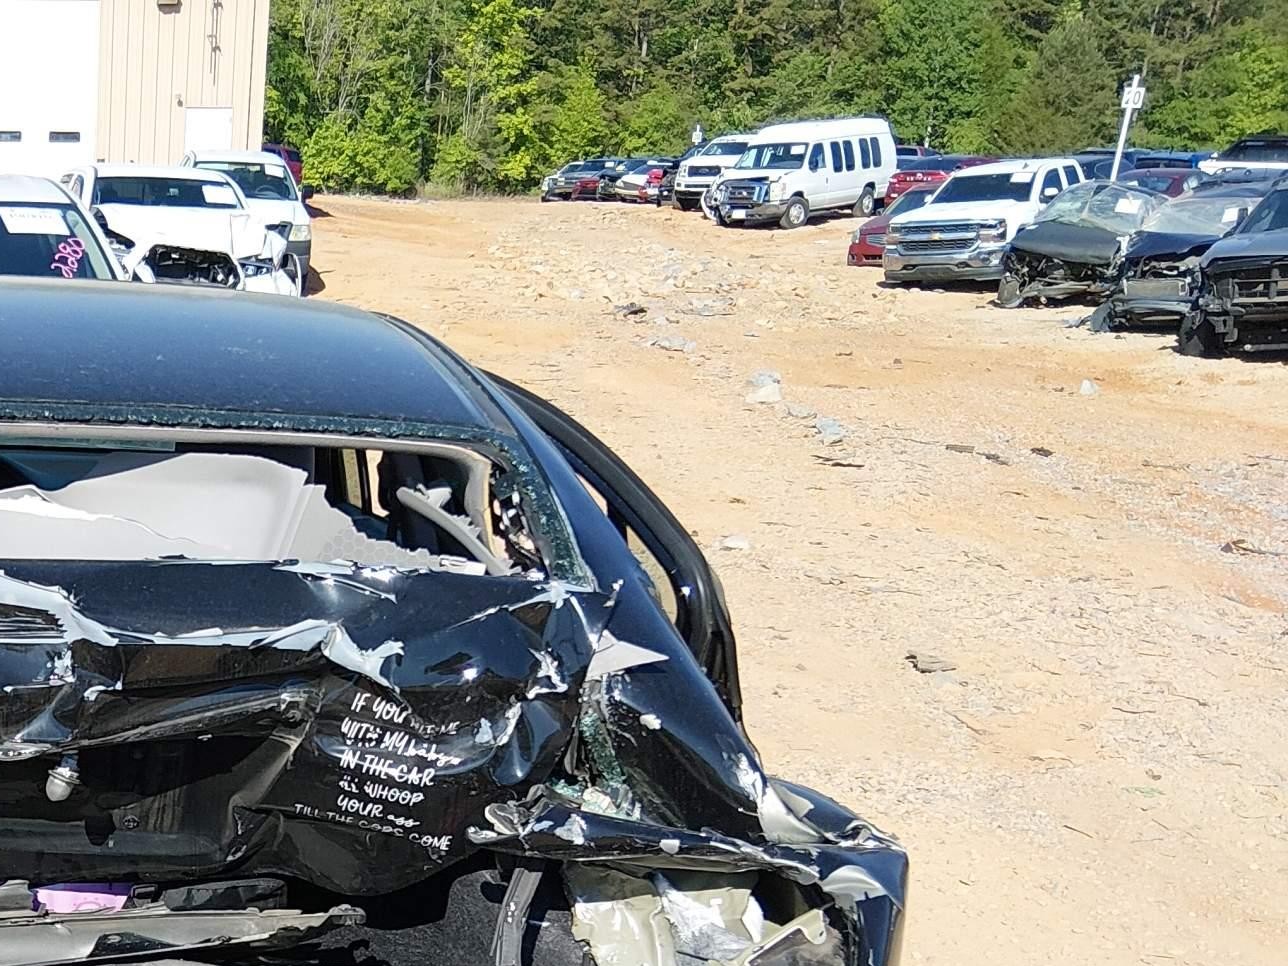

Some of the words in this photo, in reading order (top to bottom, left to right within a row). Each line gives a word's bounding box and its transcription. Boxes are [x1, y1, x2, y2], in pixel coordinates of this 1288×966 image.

[351, 692, 372, 713] IF
[372, 696, 411, 724] YOU
[380, 731, 409, 755] MY
[339, 749, 361, 769] IN
[362, 754, 394, 779] THE
[394, 765, 435, 787] CAR
[337, 794, 383, 817] YOUR
[363, 781, 425, 806] WHOOP
[294, 803, 321, 818] TILL
[326, 811, 354, 823] THE
[409, 832, 453, 850] COME
